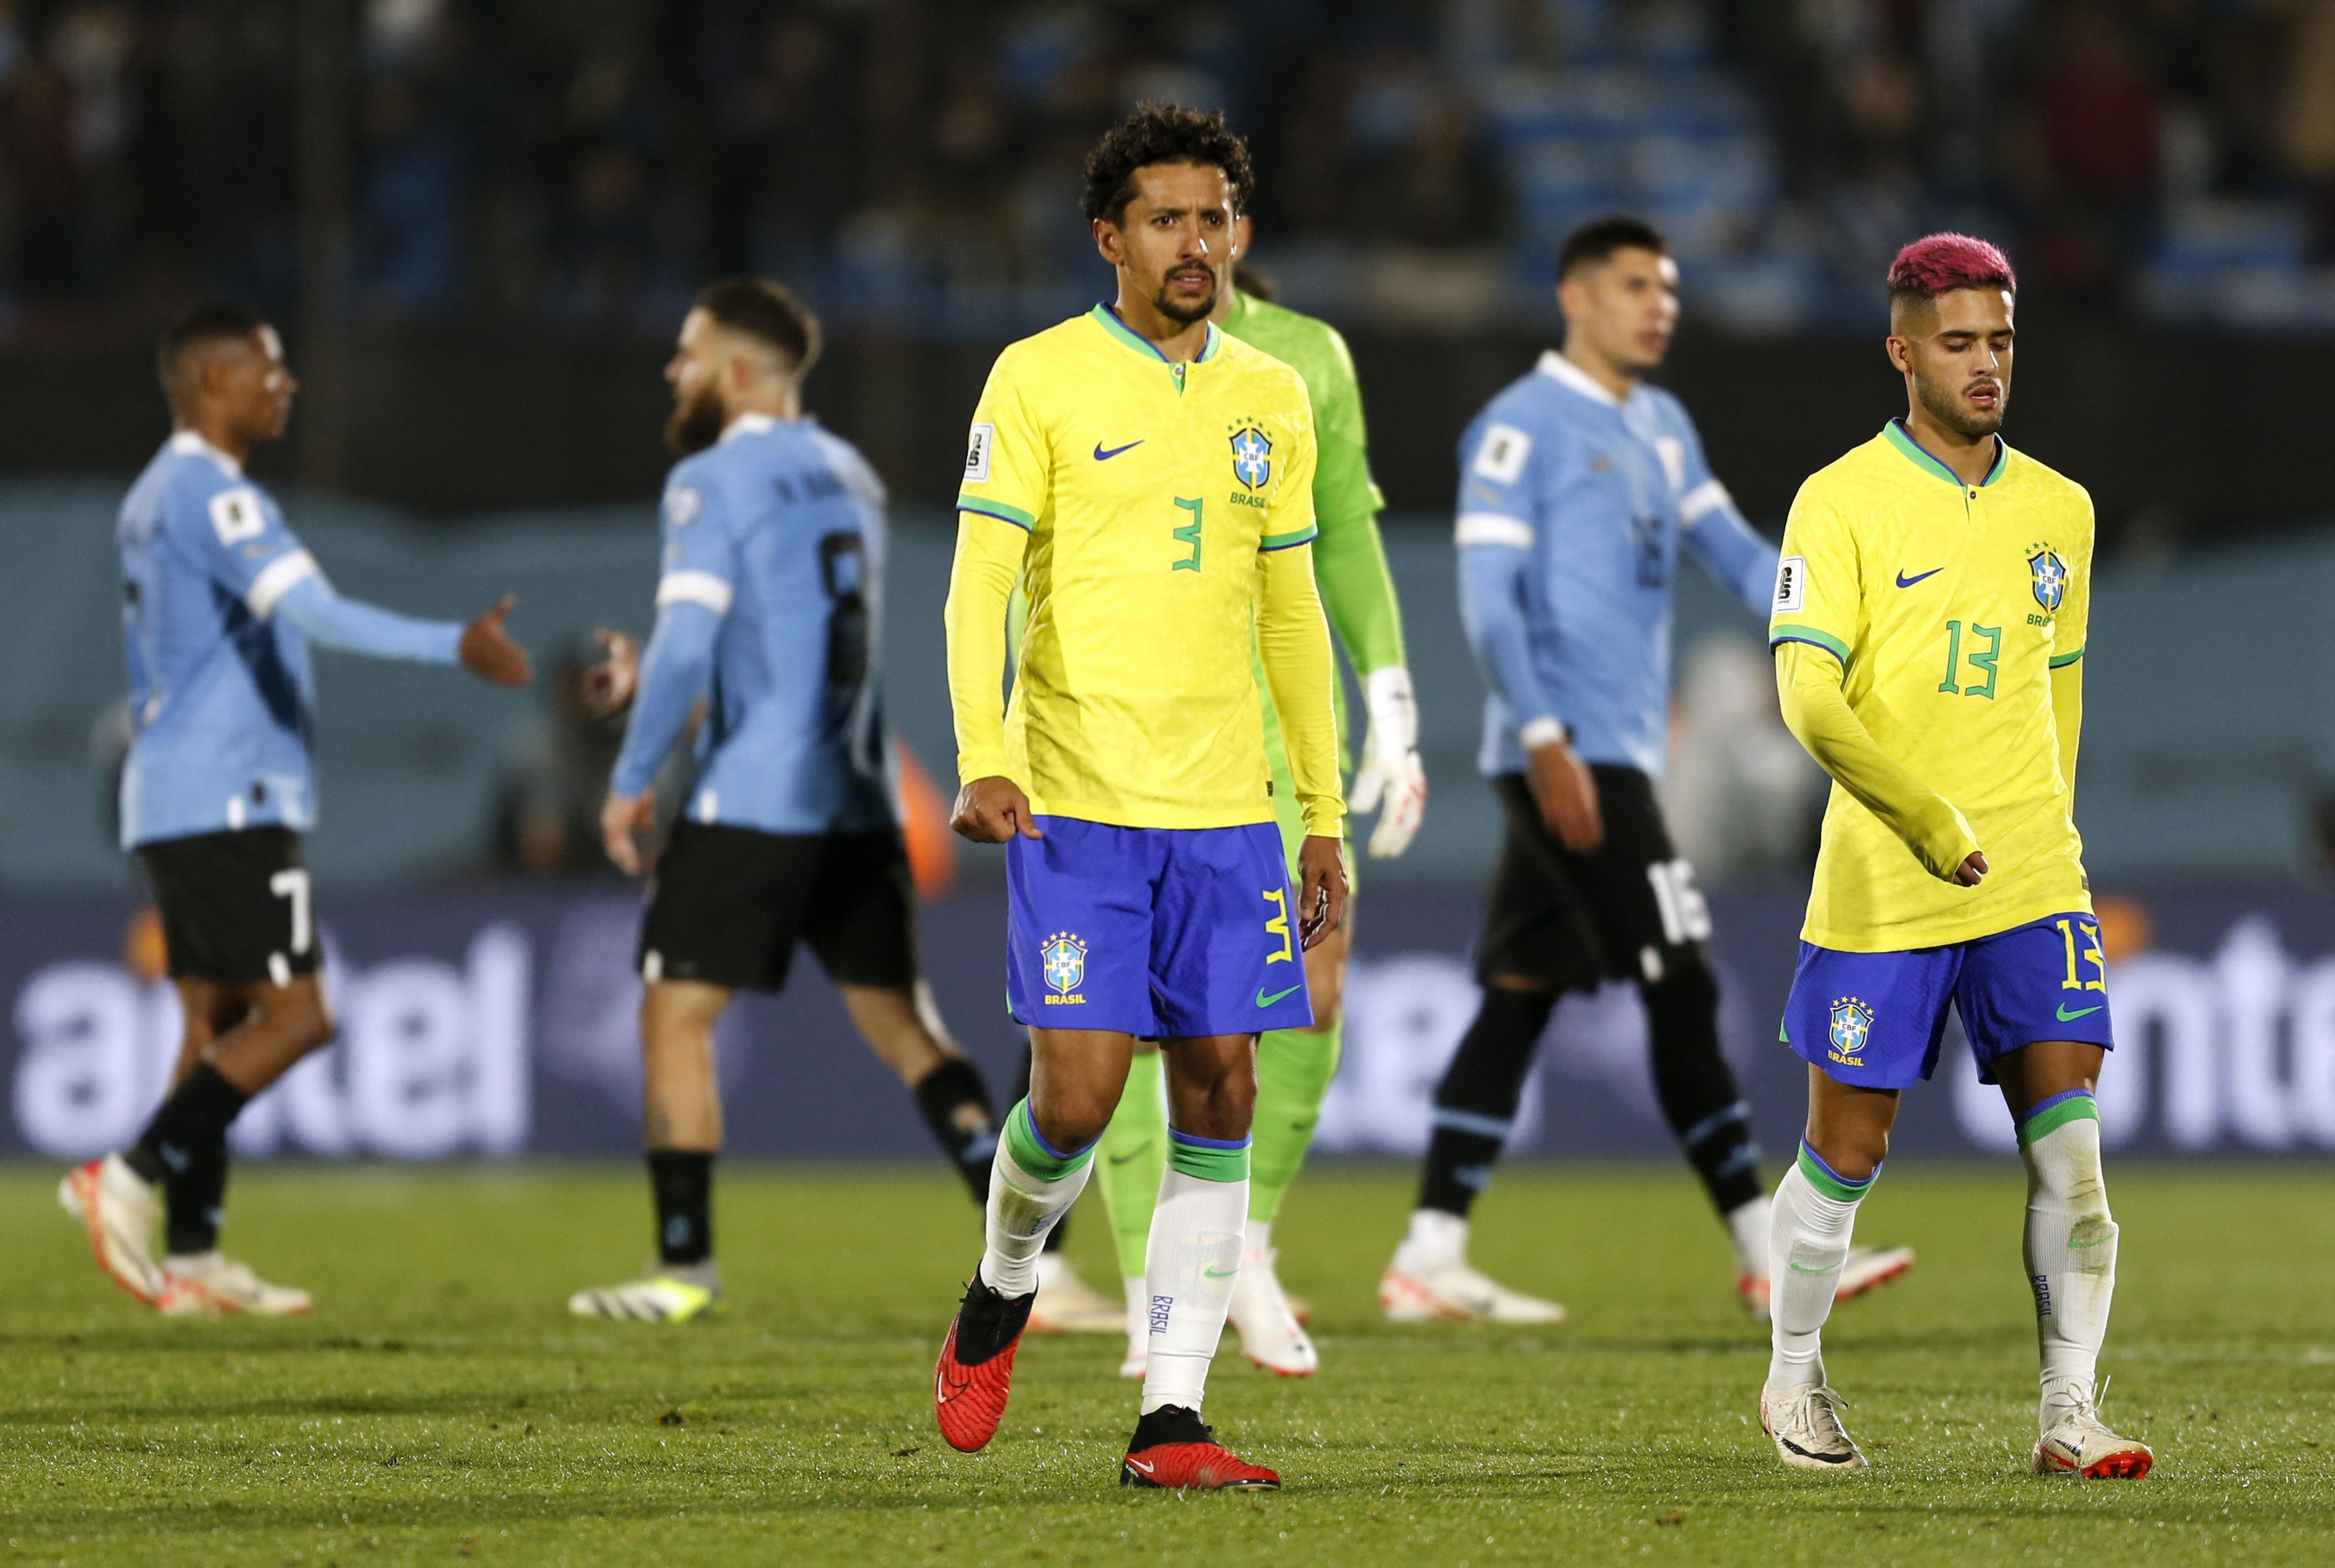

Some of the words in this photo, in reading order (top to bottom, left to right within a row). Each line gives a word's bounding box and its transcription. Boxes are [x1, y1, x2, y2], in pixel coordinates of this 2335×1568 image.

[1173, 497, 1202, 572] 3
[2042, 576, 2056, 584] CBF
[1938, 620, 2001, 700] 13
[1262, 888, 1292, 965] 3
[2056, 919, 2107, 995] 13
[1044, 993, 1086, 1005] BRASIL
[1828, 1049, 1864, 1066] BRASIL
[1150, 1295, 1173, 1336] BRASIL
